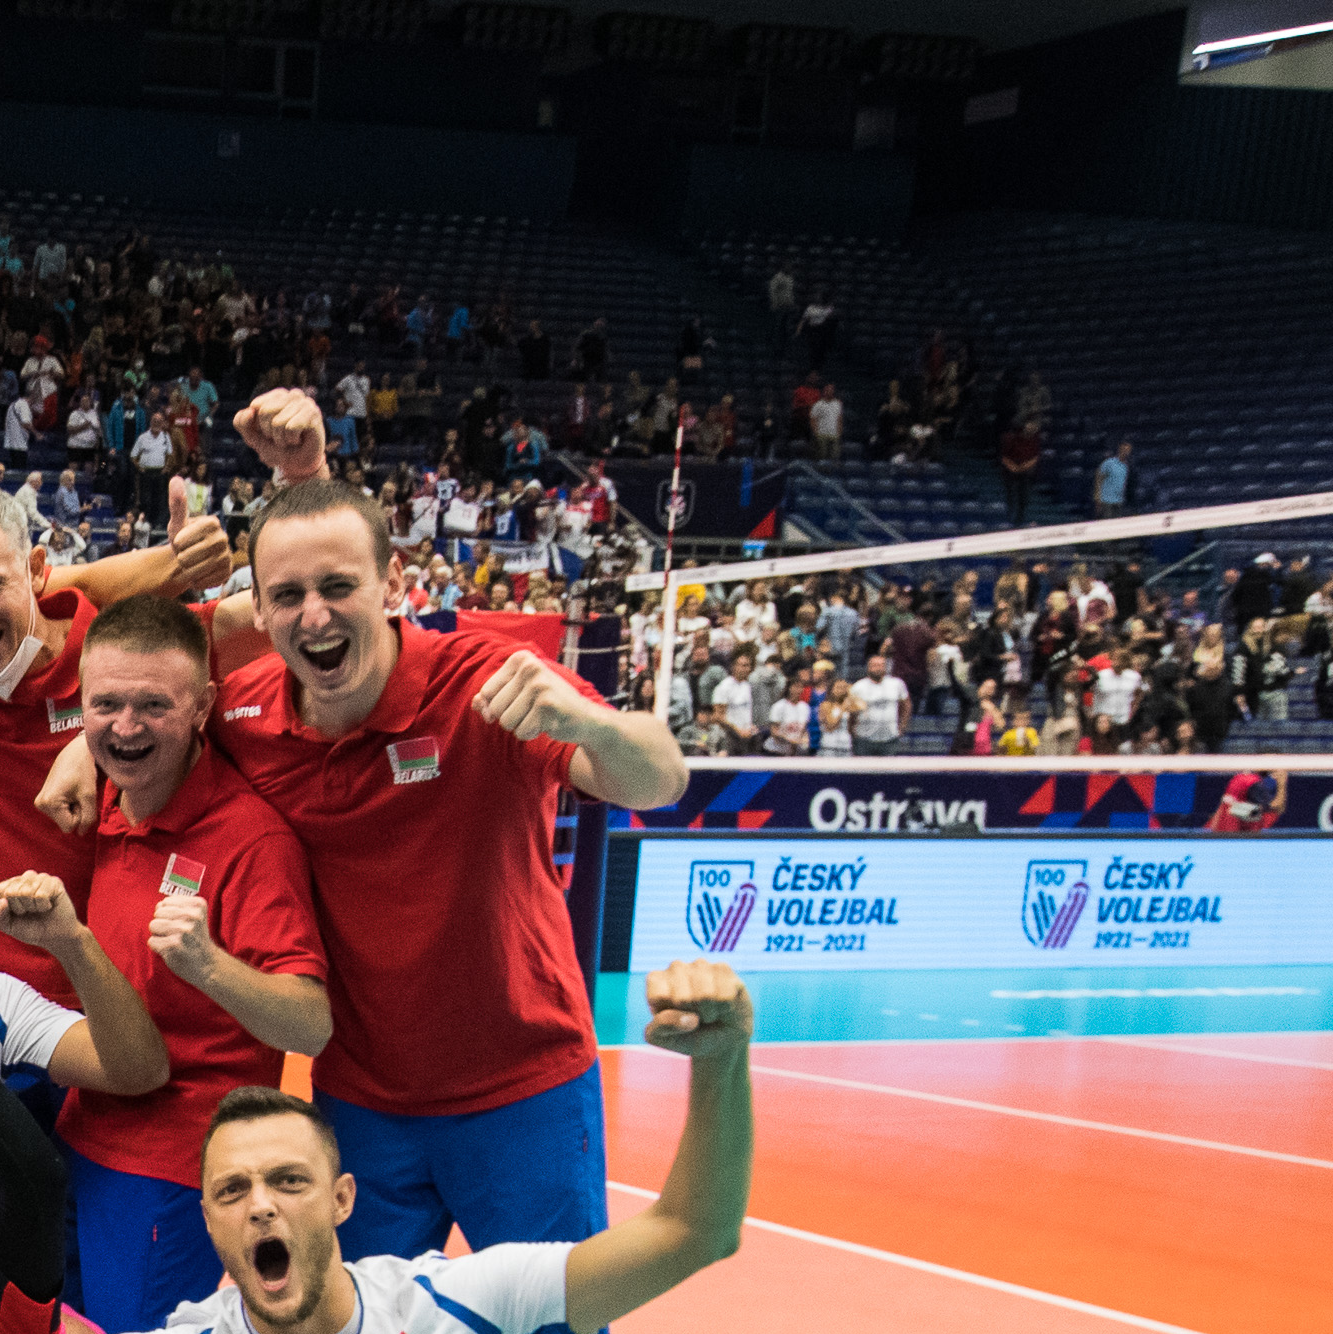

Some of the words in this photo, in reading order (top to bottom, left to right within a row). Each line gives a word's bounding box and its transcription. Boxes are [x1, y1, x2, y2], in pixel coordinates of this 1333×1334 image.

[50, 715, 83, 733] BELAR
[698, 869, 731, 888] 100
[771, 855, 867, 892] ČESKÝ
[1035, 868, 1066, 887] 100
[1102, 855, 1194, 890] ČESKÝ
[766, 897, 899, 926] VOLEJBAL
[1096, 896, 1223, 923] VOLEJBAL
